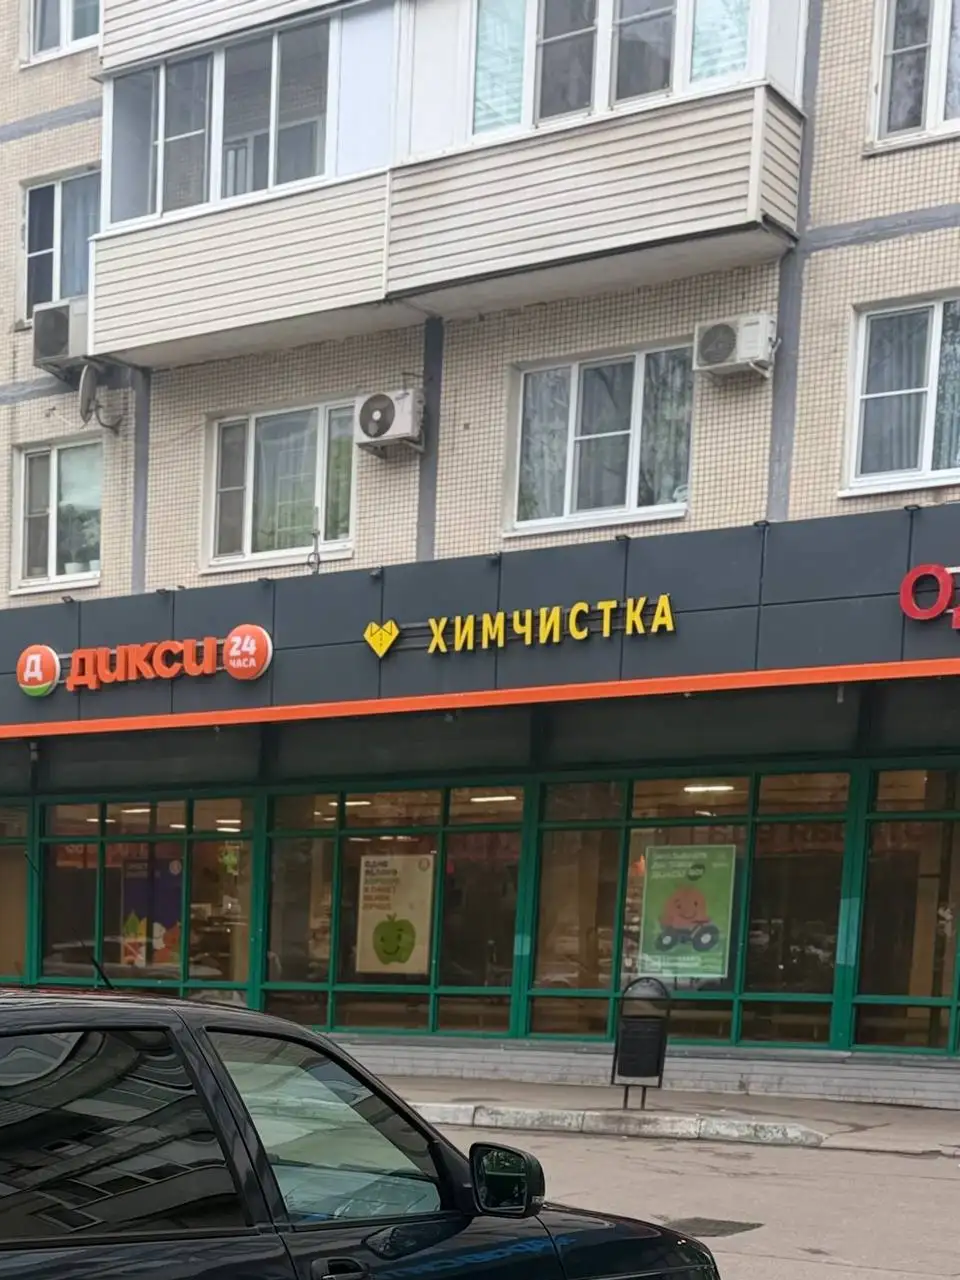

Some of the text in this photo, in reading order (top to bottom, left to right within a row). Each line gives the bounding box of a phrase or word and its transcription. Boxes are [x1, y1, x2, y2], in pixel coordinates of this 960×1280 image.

[900, 564, 960, 629] О
[427, 592, 677, 654] ХИМЧИСТКА
[66, 637, 217, 691] ДИКСИ
[229, 634, 257, 657] 24
[229, 657, 257, 668] ЧАСА
[23, 653, 43, 681] Д
